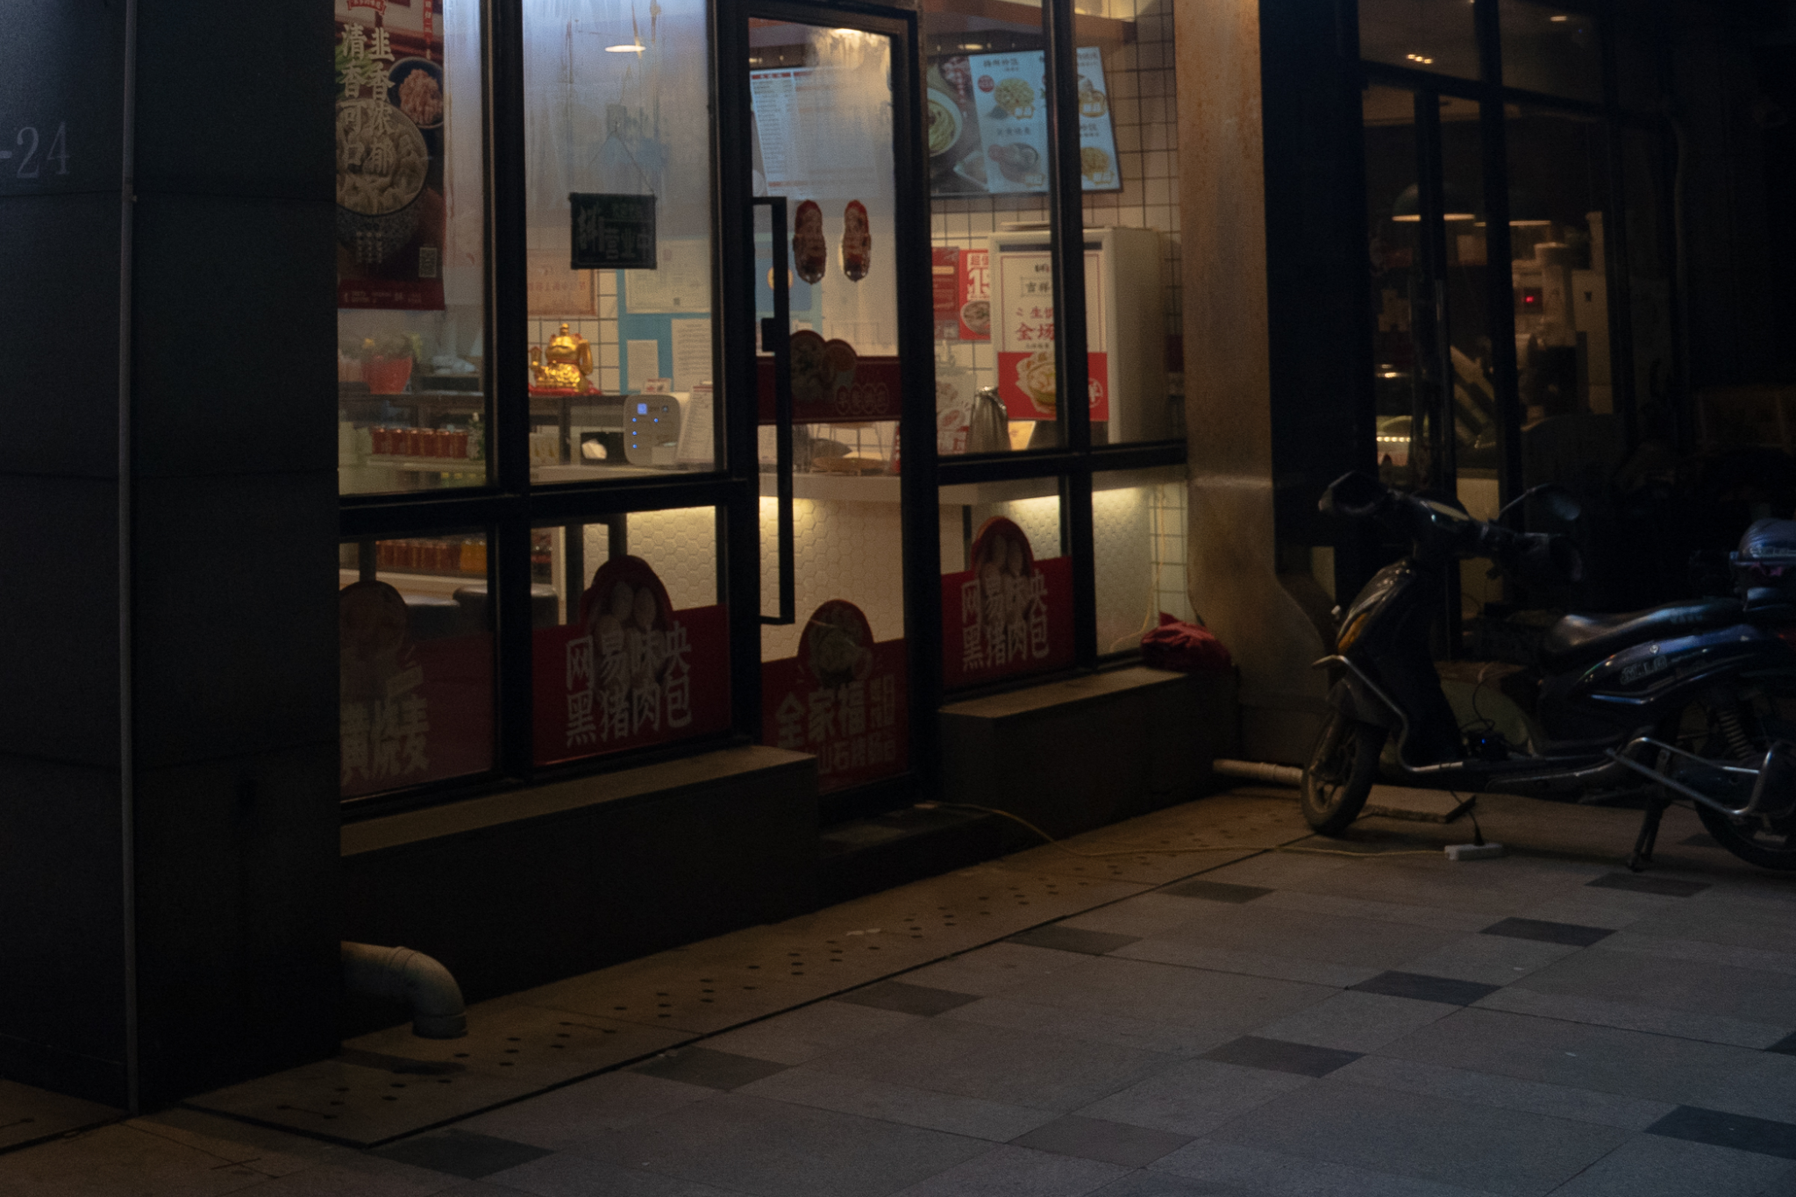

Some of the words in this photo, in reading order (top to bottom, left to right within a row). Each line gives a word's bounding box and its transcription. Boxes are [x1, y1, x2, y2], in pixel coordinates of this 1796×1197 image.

[565, 619, 693, 692] 网易味央
[962, 615, 1051, 673] 黑猪肉包
[566, 673, 693, 749] 黑猪肉包
